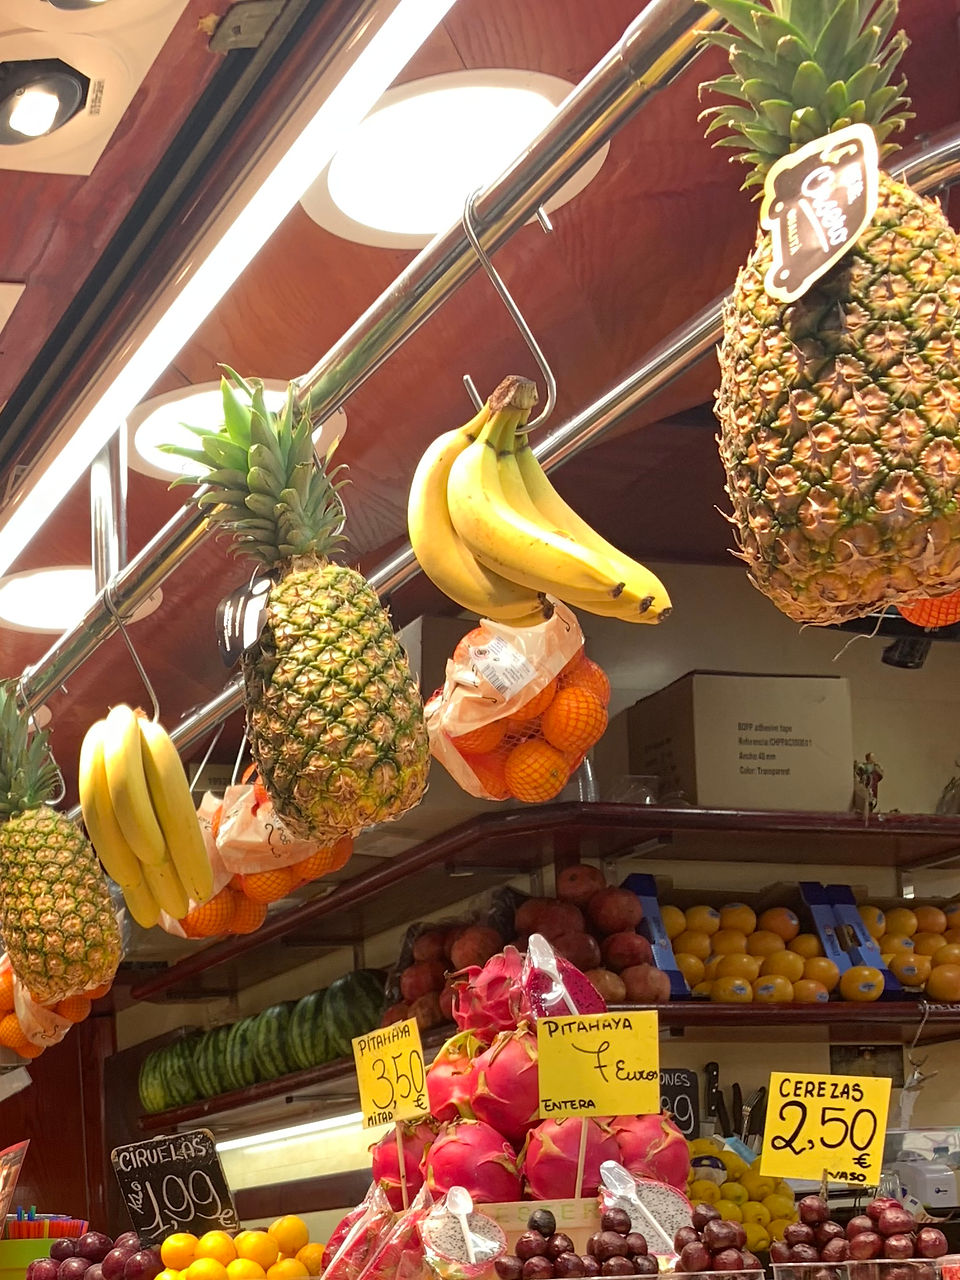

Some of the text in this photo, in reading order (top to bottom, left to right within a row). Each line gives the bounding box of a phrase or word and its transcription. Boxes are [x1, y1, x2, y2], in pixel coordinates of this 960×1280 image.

[371, 1049, 425, 1111] 3,50
[615, 1059, 659, 1082] Euros
[778, 1077, 865, 1103] CEREZAS
[541, 1098, 596, 1112] ENTERA
[770, 1099, 878, 1156] 2,50
[118, 1137, 208, 1173] CIRUELAS
[851, 1152, 872, 1169] €
[827, 1171, 867, 1182] VASO
